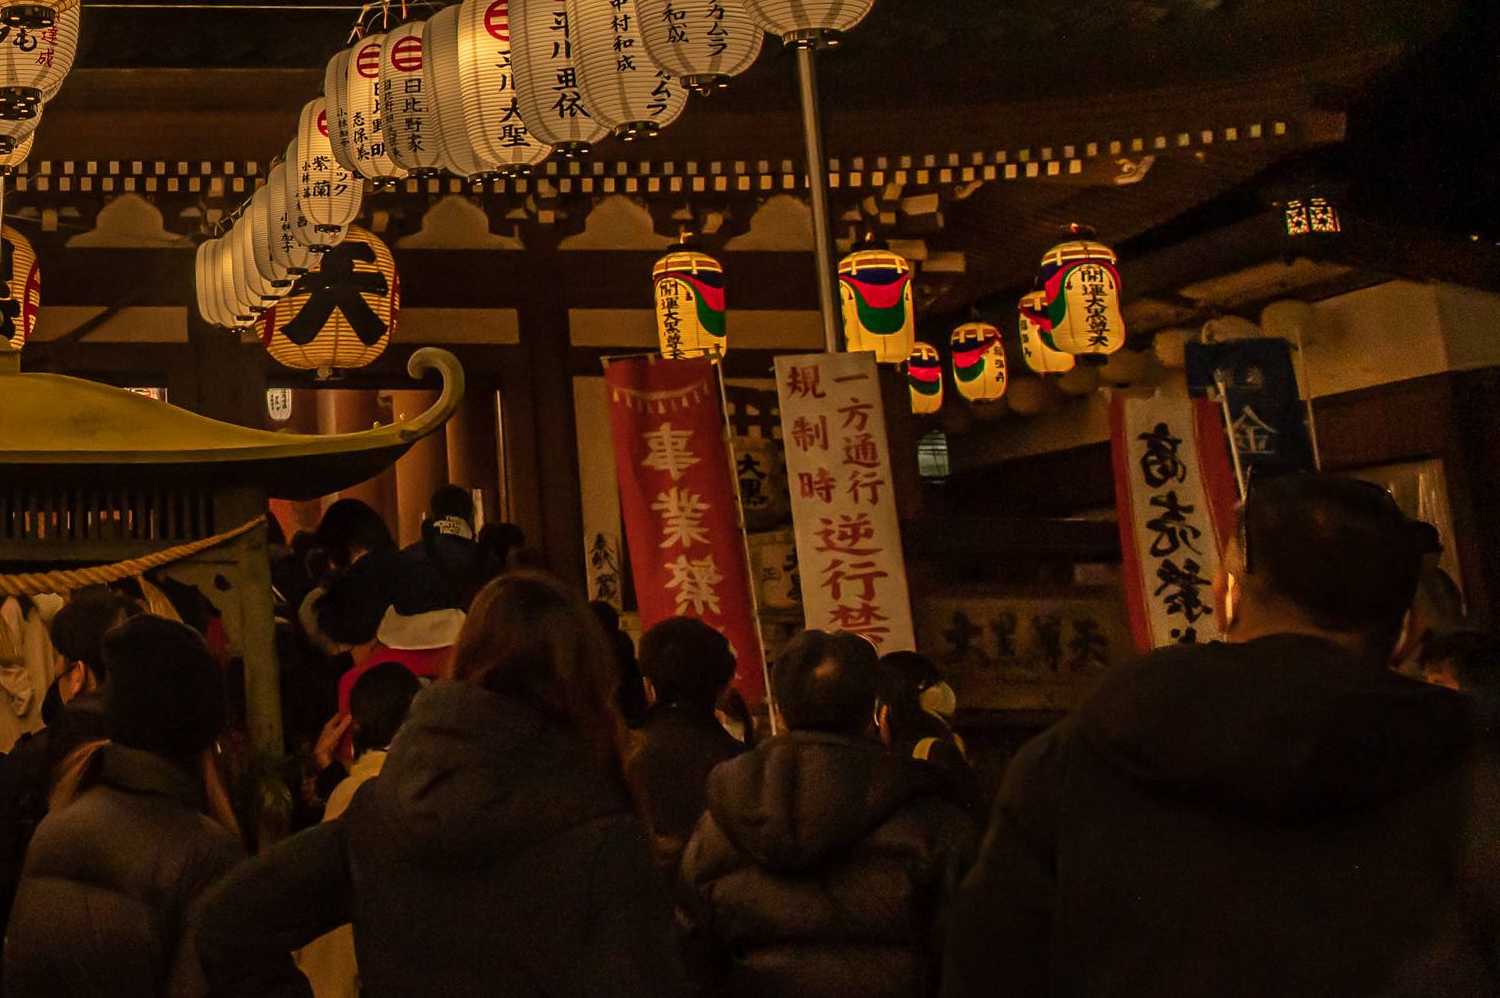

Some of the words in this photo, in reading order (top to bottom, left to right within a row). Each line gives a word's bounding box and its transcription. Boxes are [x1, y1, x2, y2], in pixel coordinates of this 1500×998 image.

[402, 78, 426, 152] 日比野家
[312, 155, 331, 197] 紫蘭
[332, 159, 348, 196] ック
[1081, 269, 1110, 348] 開運大黒尊天
[785, 363, 837, 504] 規制時
[831, 372, 886, 506] 一方通行
